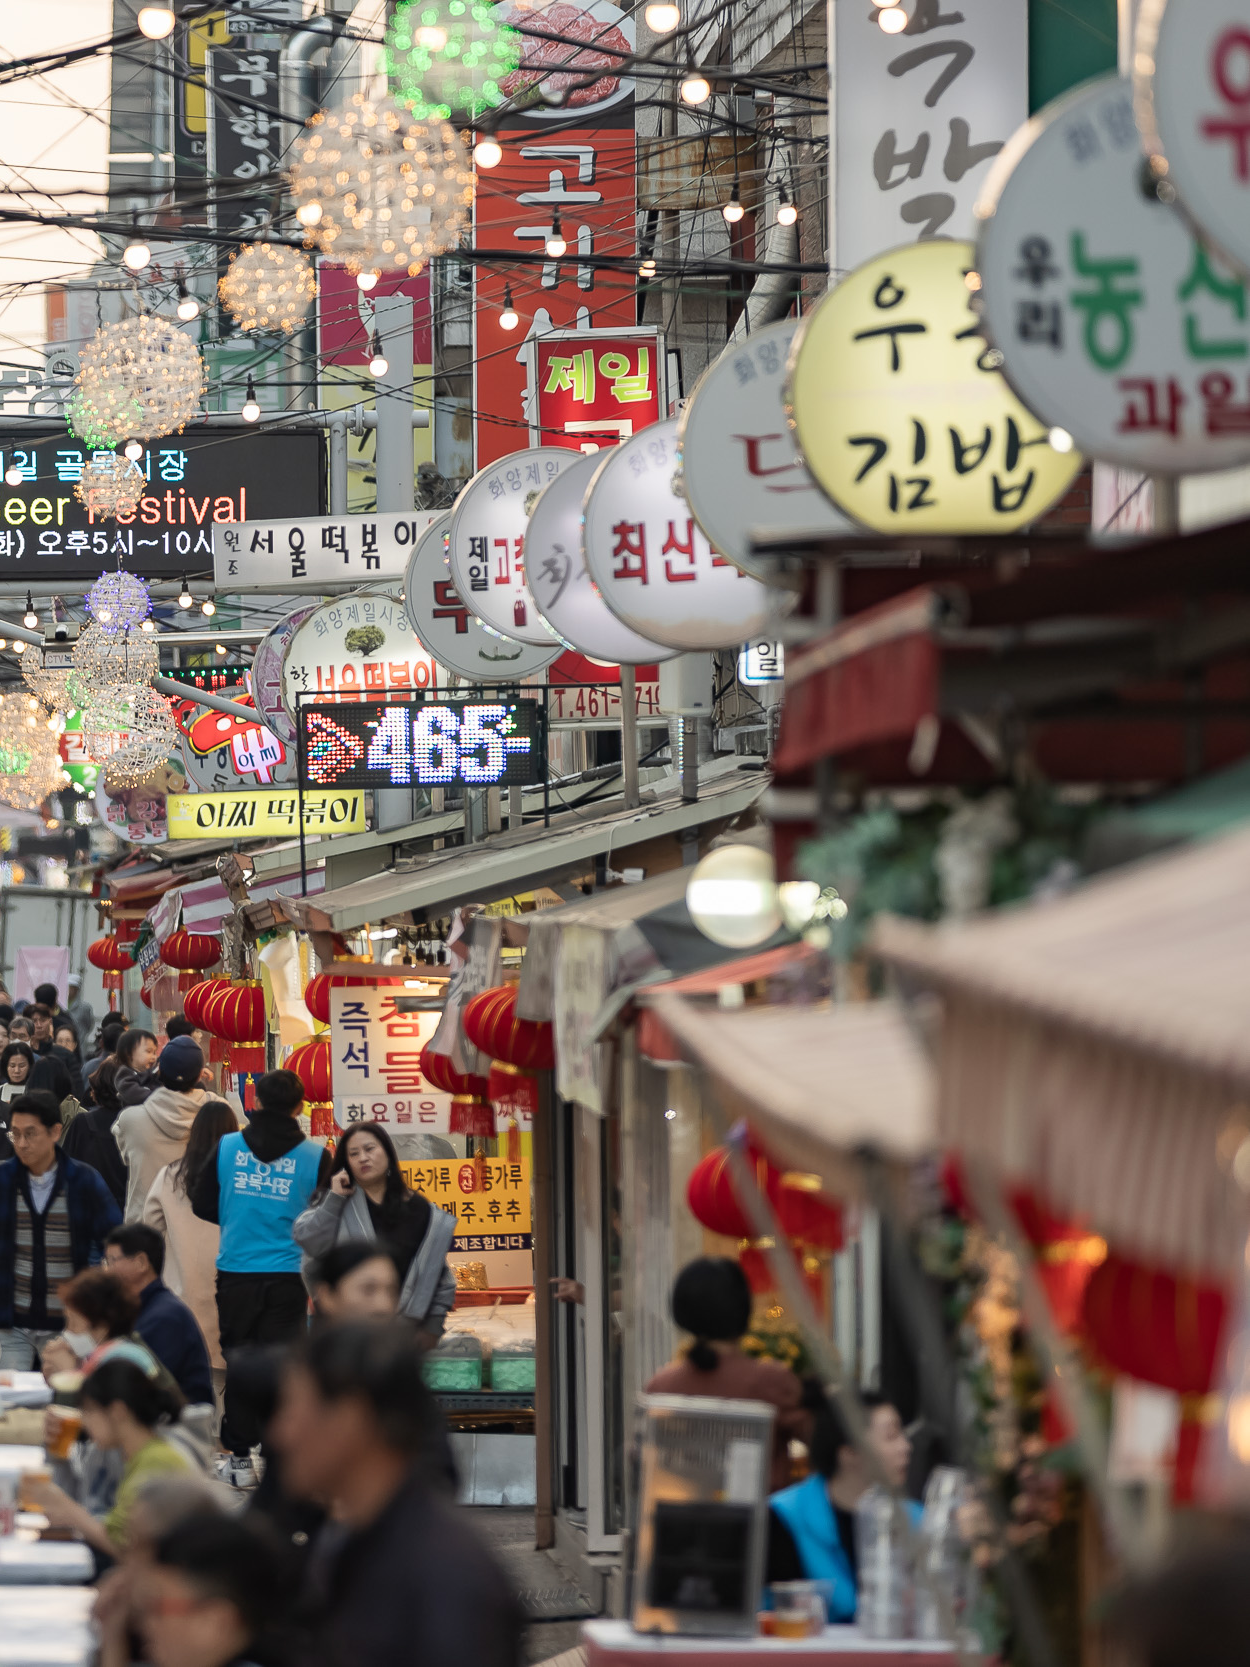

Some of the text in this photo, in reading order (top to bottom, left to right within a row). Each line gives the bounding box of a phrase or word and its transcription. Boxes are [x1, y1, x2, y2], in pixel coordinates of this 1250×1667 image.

[544, 346, 652, 405] 제일
[847, 417, 1050, 514] 김밥
[88, 487, 246, 525] Festival
[250, 520, 417, 579] 서울떡볶이
[468, 535, 490, 592] 제일
[339, 1002, 372, 1079] 즉석
[454, 1235, 524, 1251] 제조합니다
